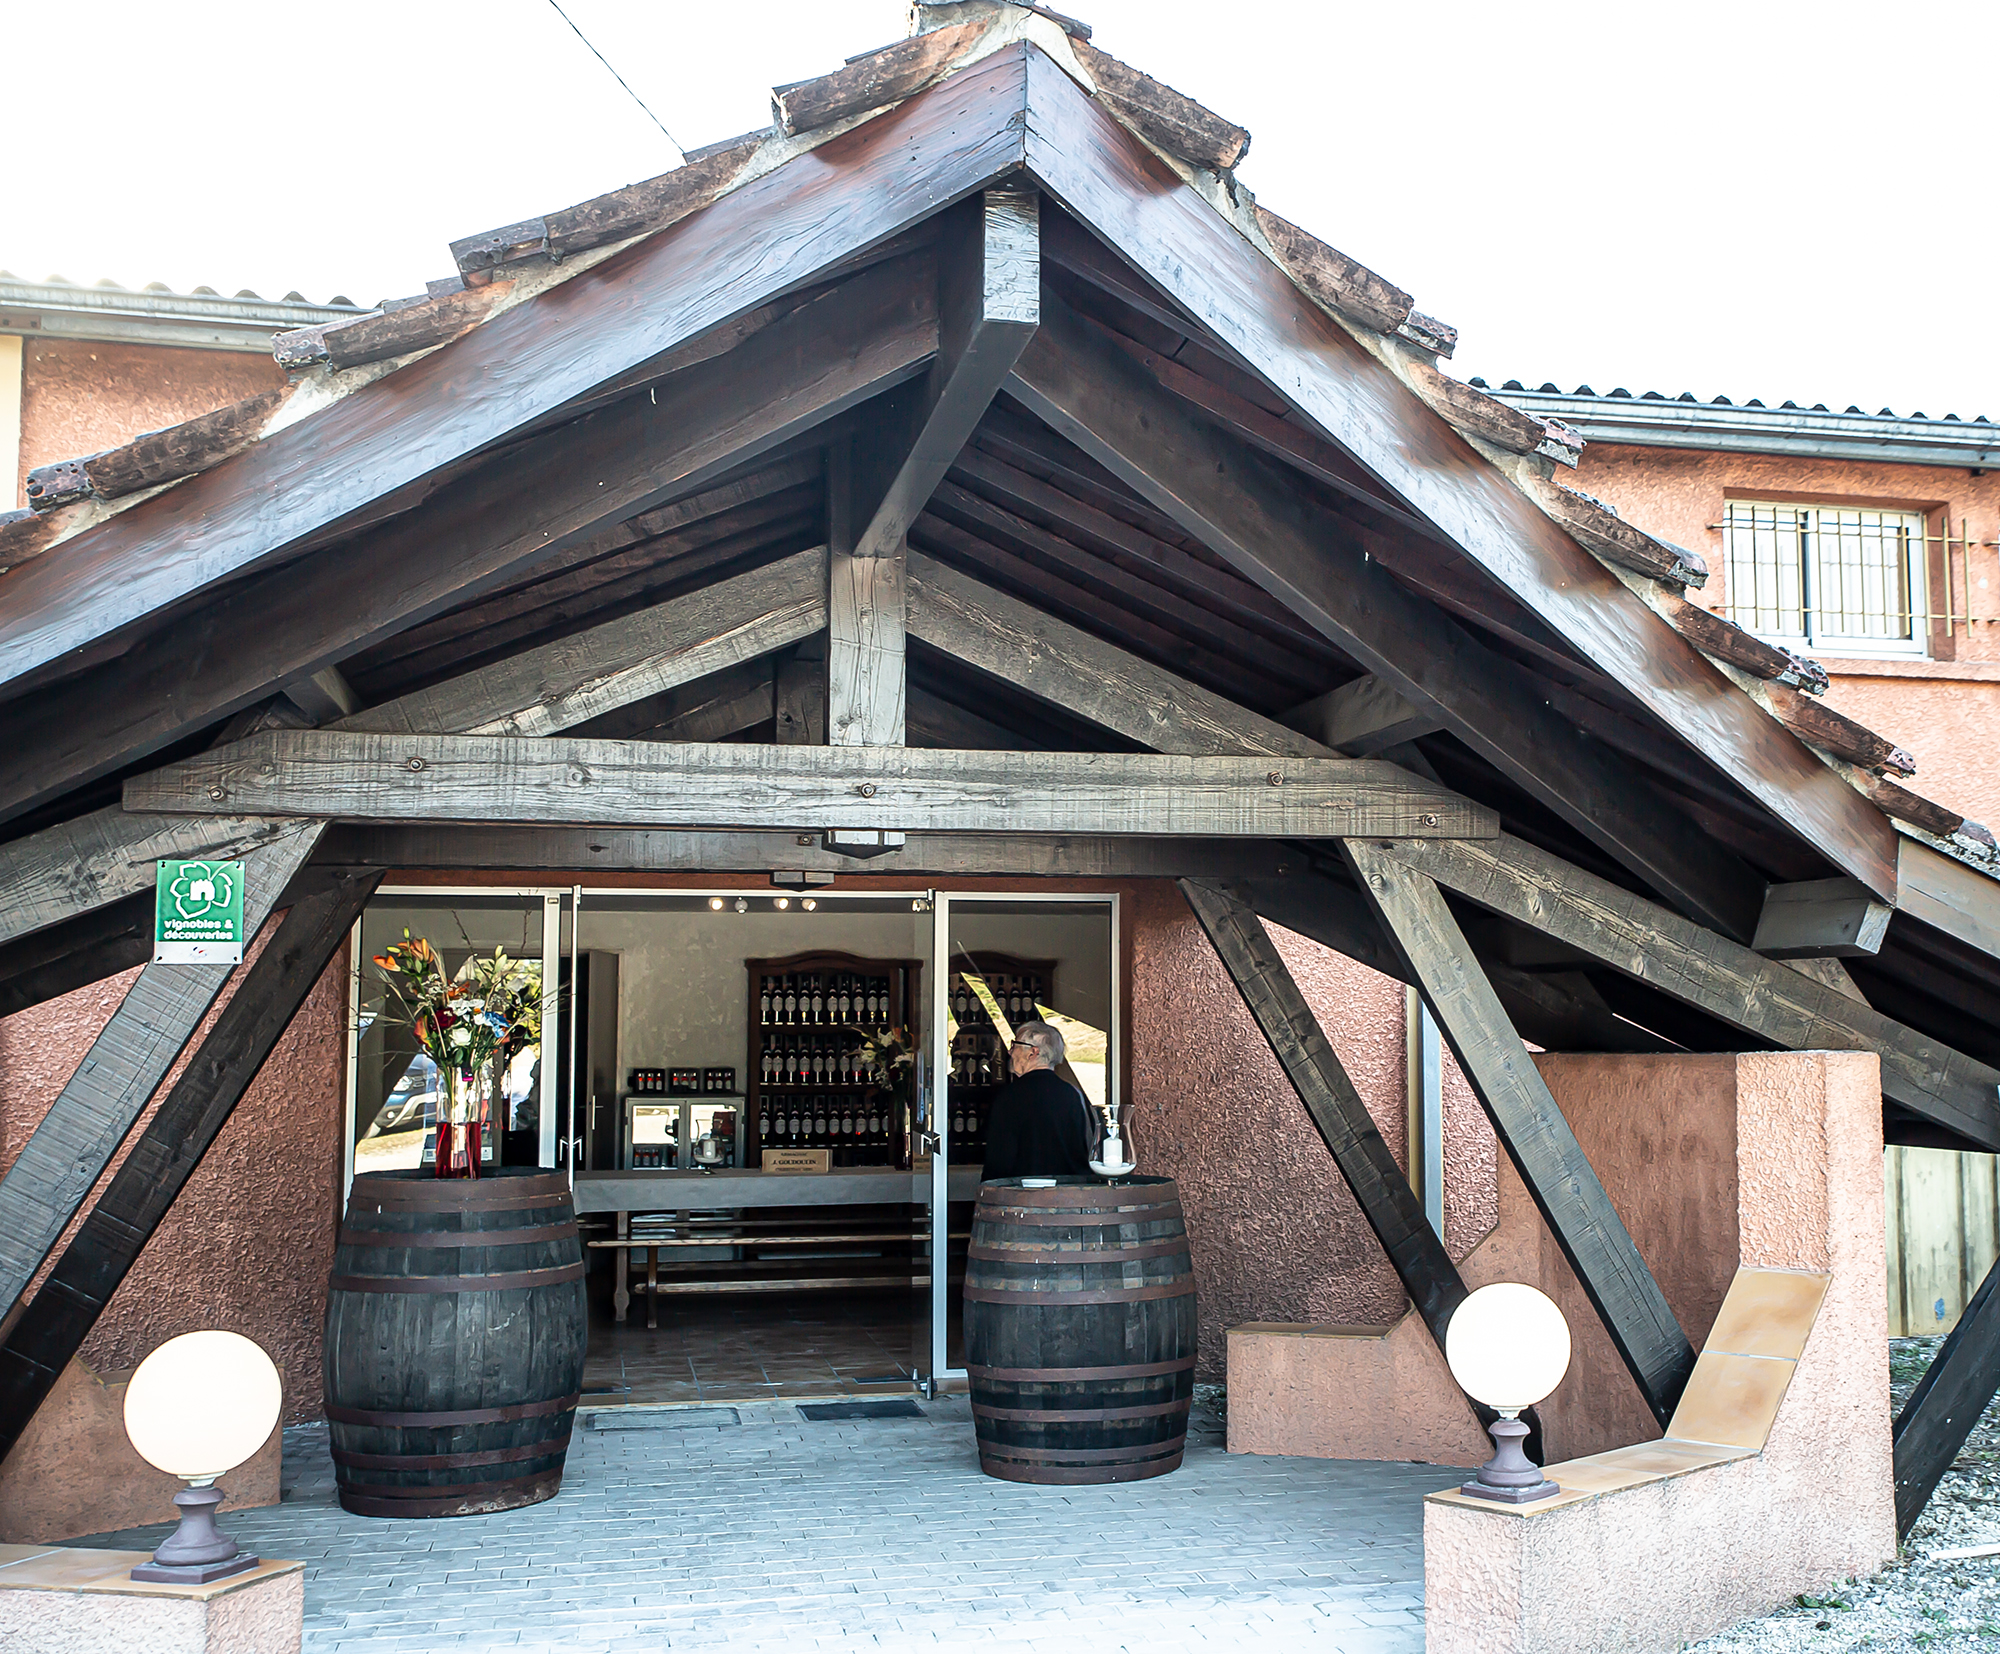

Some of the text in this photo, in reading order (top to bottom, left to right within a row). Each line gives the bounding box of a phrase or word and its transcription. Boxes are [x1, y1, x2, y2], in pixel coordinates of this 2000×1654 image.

[164, 919, 234, 930] vignobles &
[163, 930, 234, 940] découvertes
